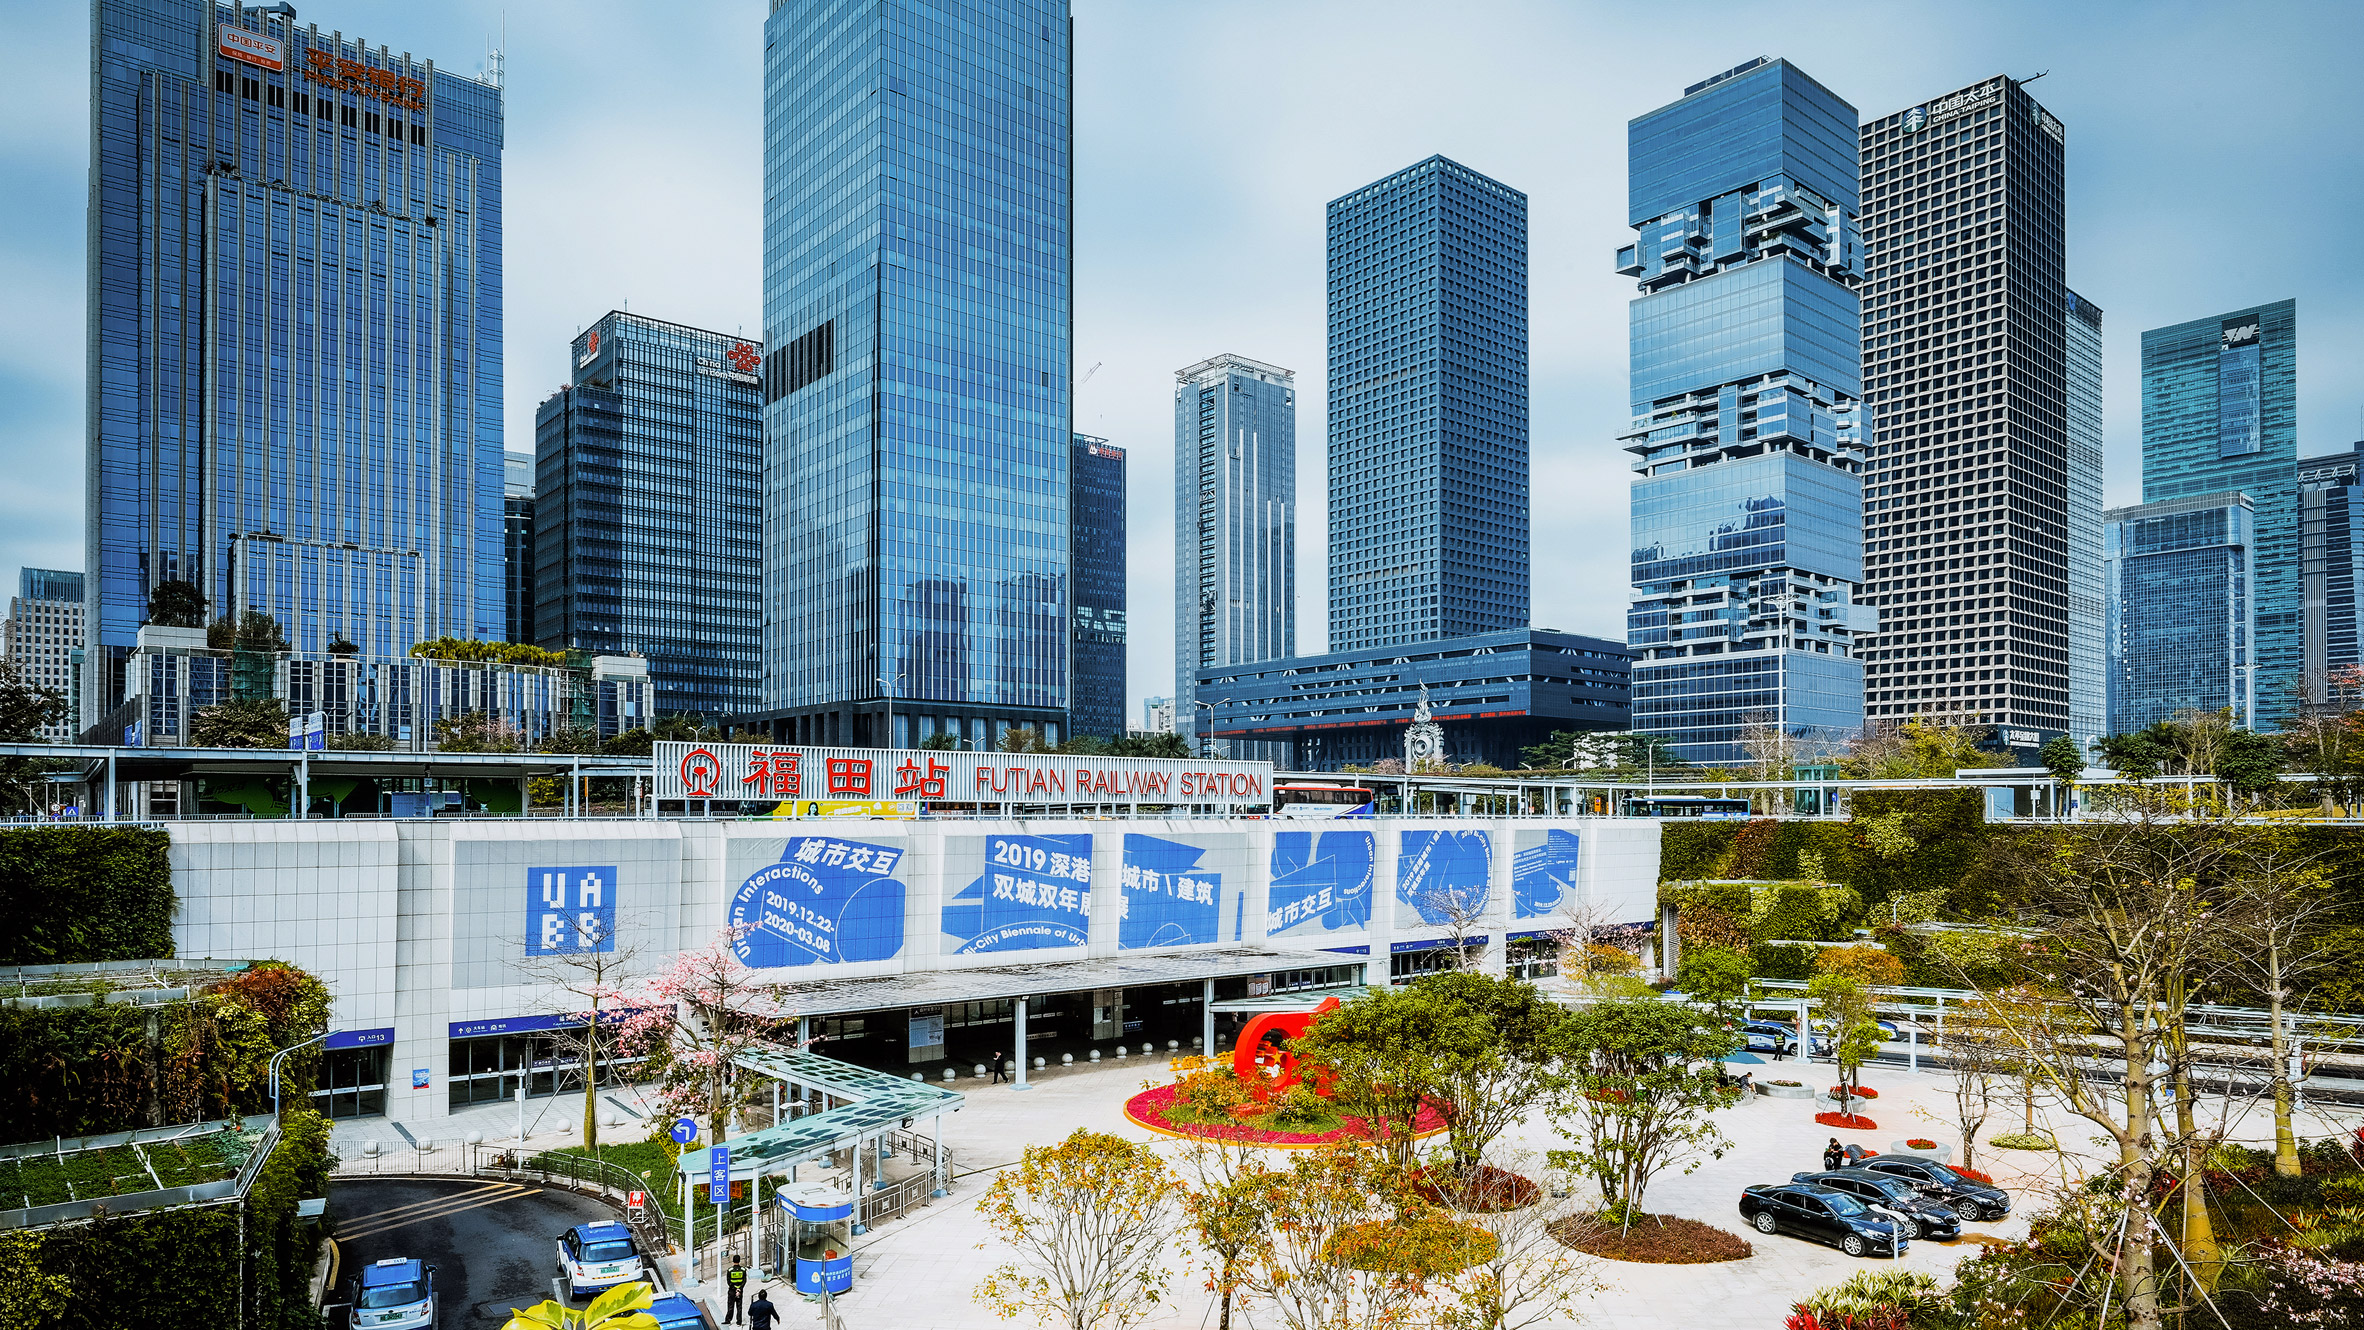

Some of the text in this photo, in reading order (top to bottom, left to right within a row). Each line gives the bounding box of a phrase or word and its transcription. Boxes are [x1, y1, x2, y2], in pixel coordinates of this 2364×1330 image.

[227, 33, 276, 55] 中国平安
[304, 70, 424, 112] PING AN BANK
[305, 47, 426, 98] 平安银行
[1932, 82, 1996, 115] 中国太平
[1932, 95, 1997, 123] CHINA TAIPING
[742, 750, 951, 798] 福田站
[976, 766, 1263, 797] FUTIAN RAILWAY STATION
[794, 838, 899, 876] 城市交互
[994, 840, 1091, 883] 2019 深港
[1343, 835, 1374, 895] Urban Interactions
[737, 865, 824, 903] Interactions
[1121, 863, 1160, 893] 城市
[1176, 876, 1214, 906] 建筑
[766, 890, 835, 933] 2019.12.22-
[1267, 886, 1333, 932] 城市交互
[763, 910, 831, 953] 2020-03.08
[1000, 926, 1052, 939] Biennale
[1054, 930, 1067, 938] of
[714, 1152, 726, 1197] 上客区
